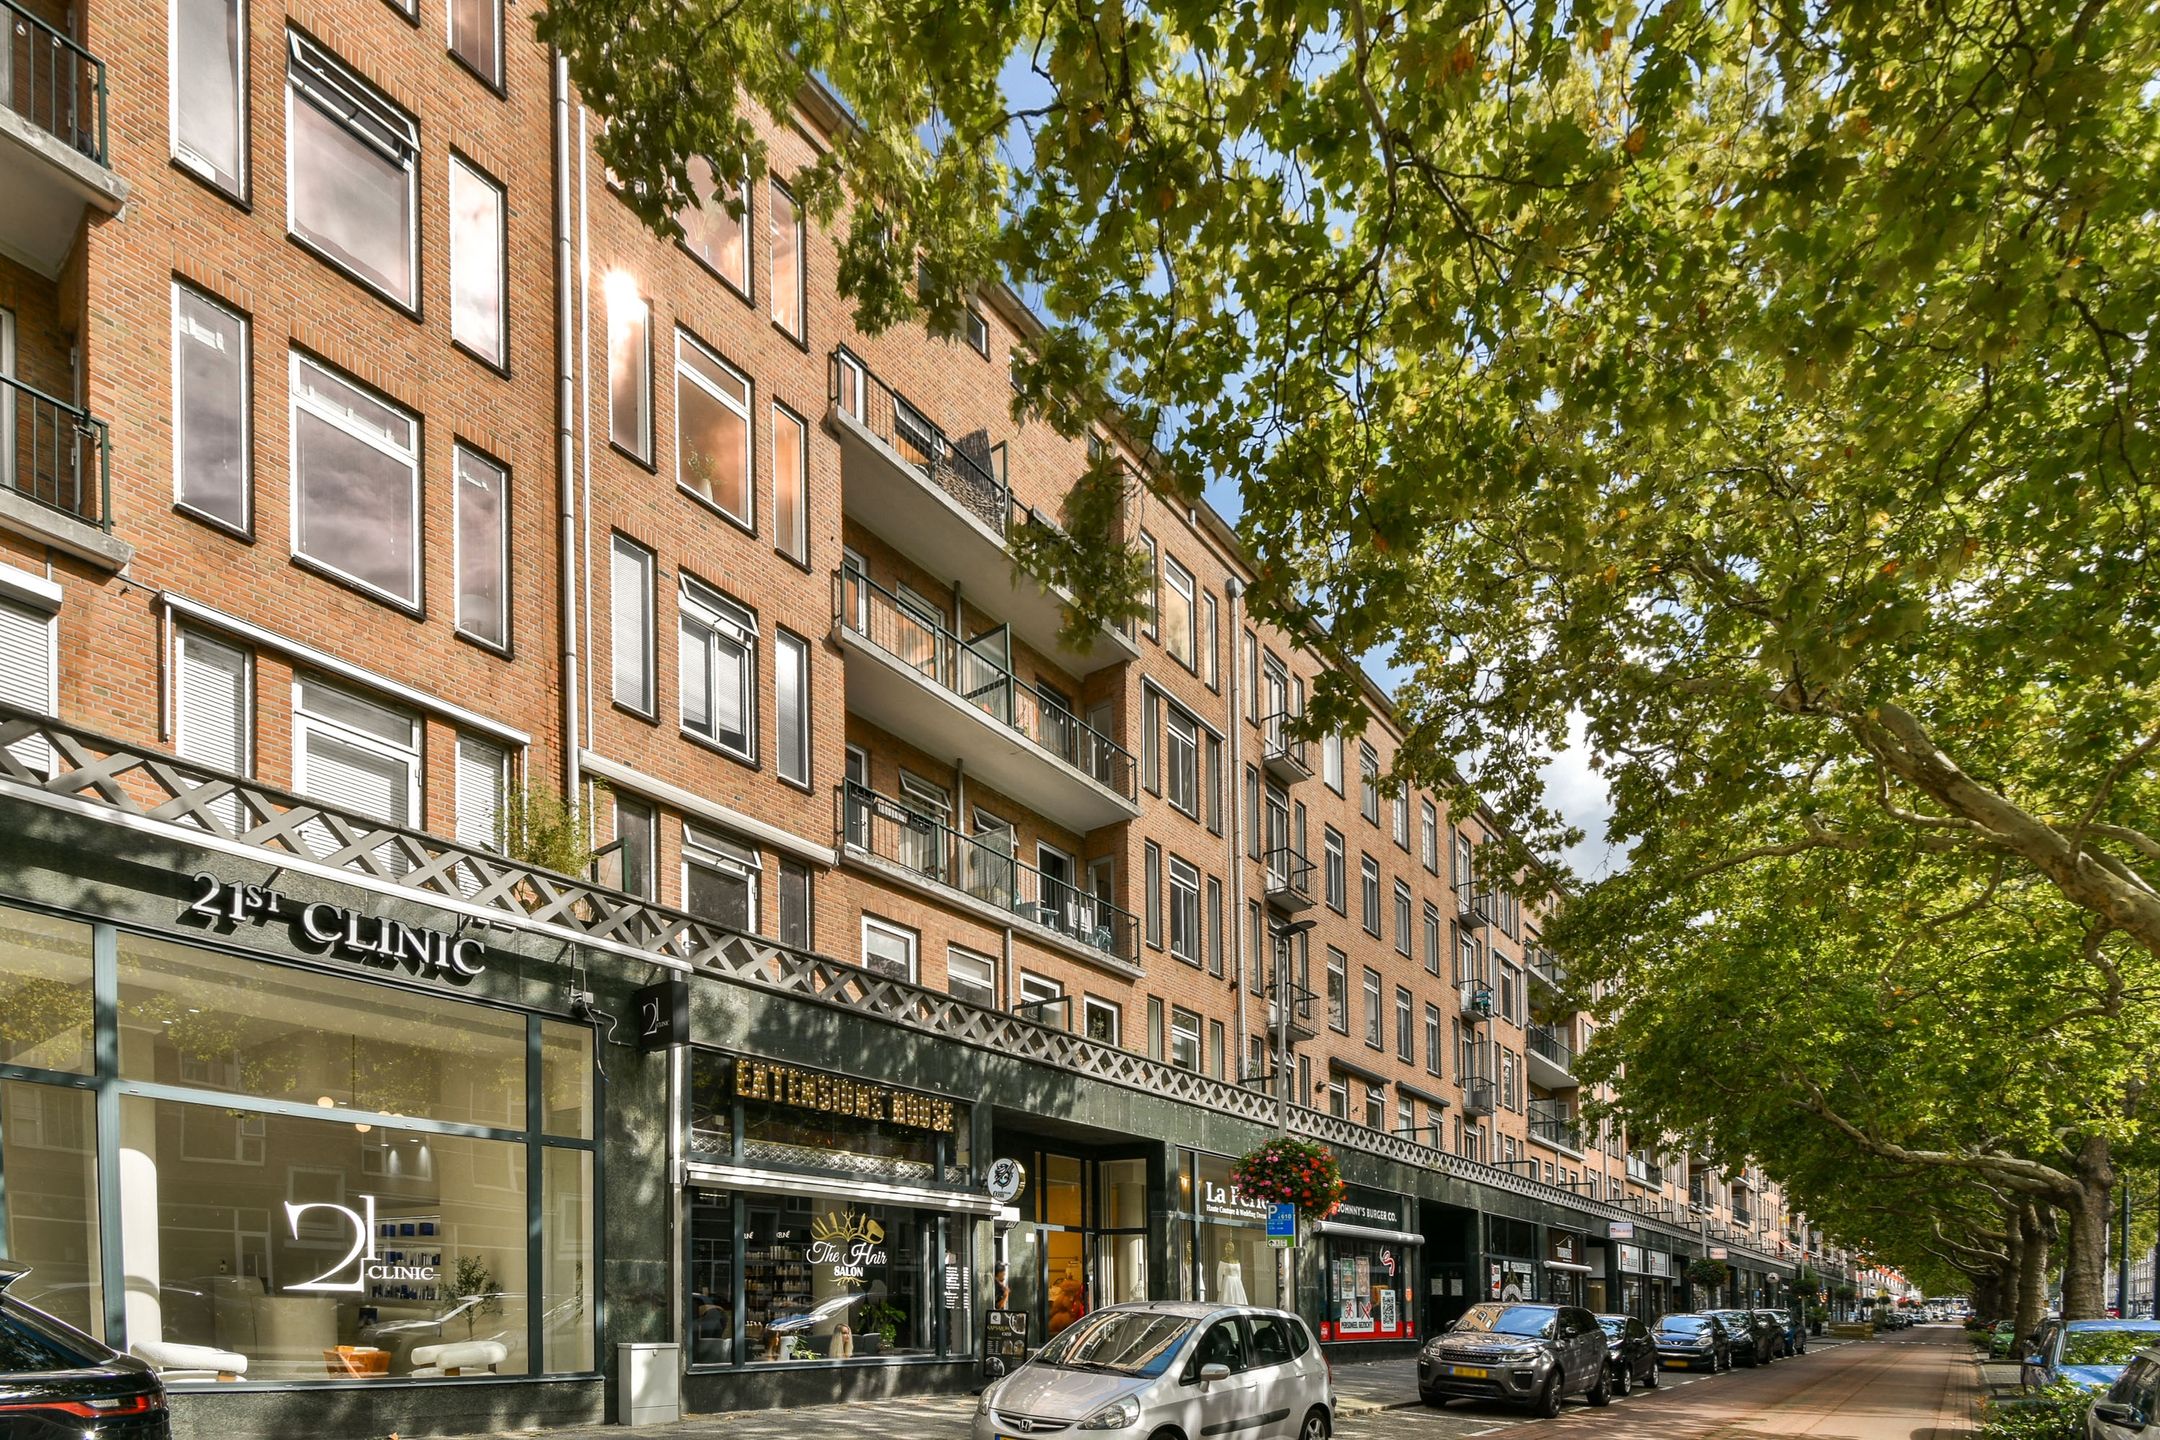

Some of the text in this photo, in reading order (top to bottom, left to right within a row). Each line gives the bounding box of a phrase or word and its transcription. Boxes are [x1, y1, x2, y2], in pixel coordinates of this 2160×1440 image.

[303, 901, 486, 976] CLINIC
[642, 997, 659, 1036] 21
[735, 1058, 954, 1132] EXTENSIONS HOUSE
[1206, 1181, 1226, 1204] La
[1268, 1205, 1278, 1220] P
[1337, 1203, 1398, 1222] JOHNNY'S BURGER CO.
[282, 1194, 381, 1293] 21
[806, 1241, 887, 1267] The Hair
[367, 1265, 435, 1281] CLINIC
[833, 1265, 864, 1278] SALON
